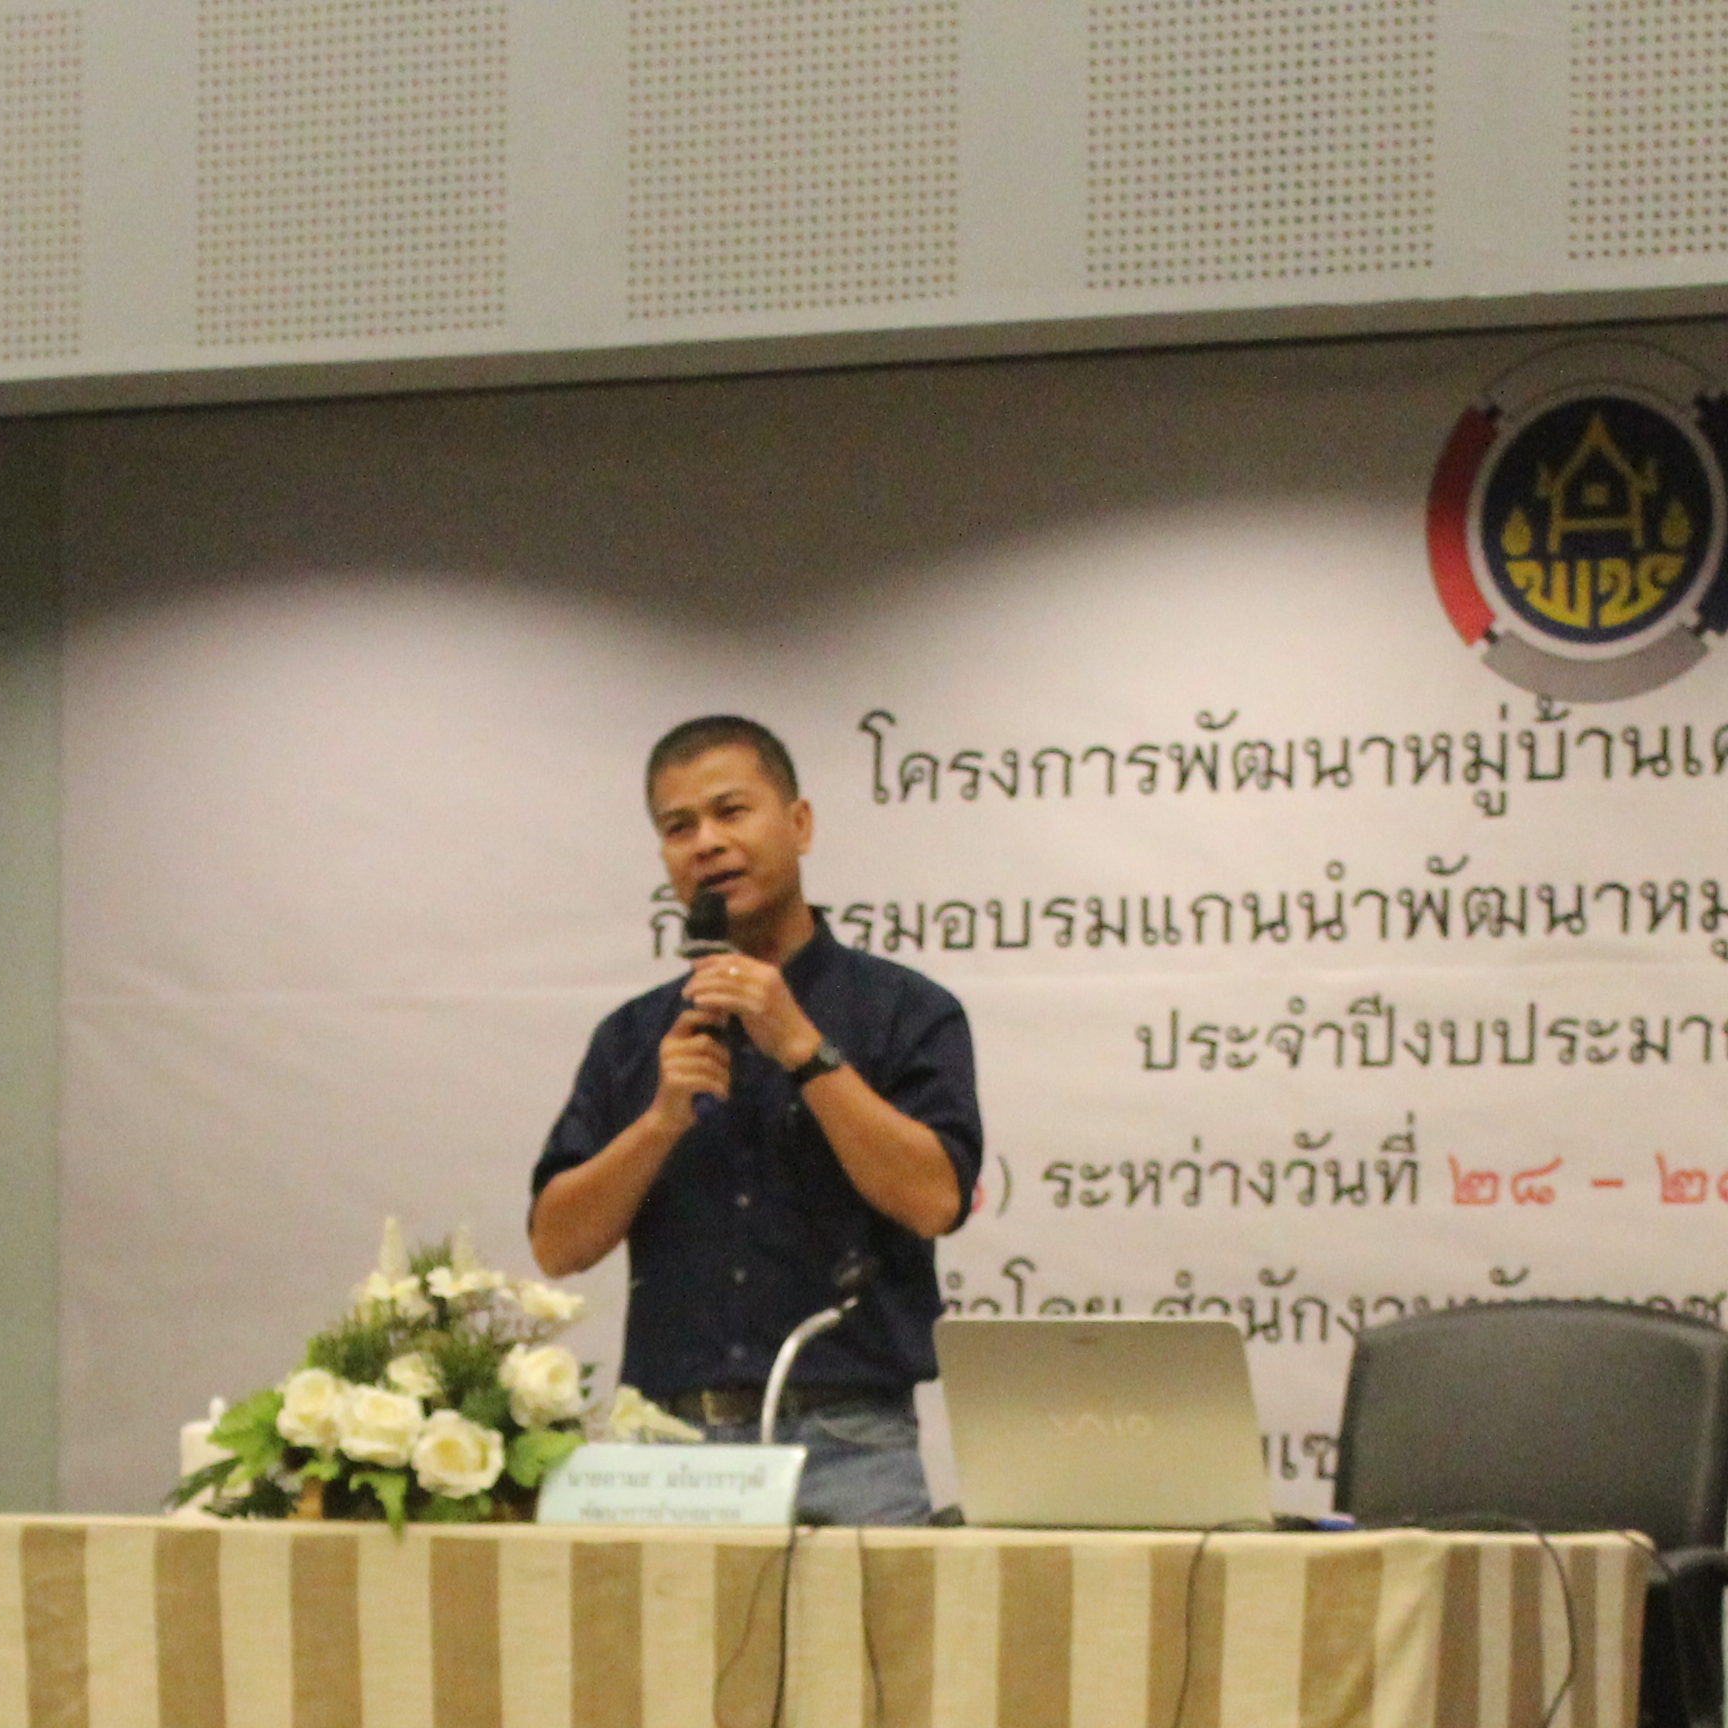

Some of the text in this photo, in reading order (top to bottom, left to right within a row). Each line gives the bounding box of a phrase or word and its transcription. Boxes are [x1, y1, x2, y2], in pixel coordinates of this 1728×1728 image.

[1041, 1112, 1421, 1209] ระหว่างวันที่
[1446, 1153, 1565, 1207] ๒๘
